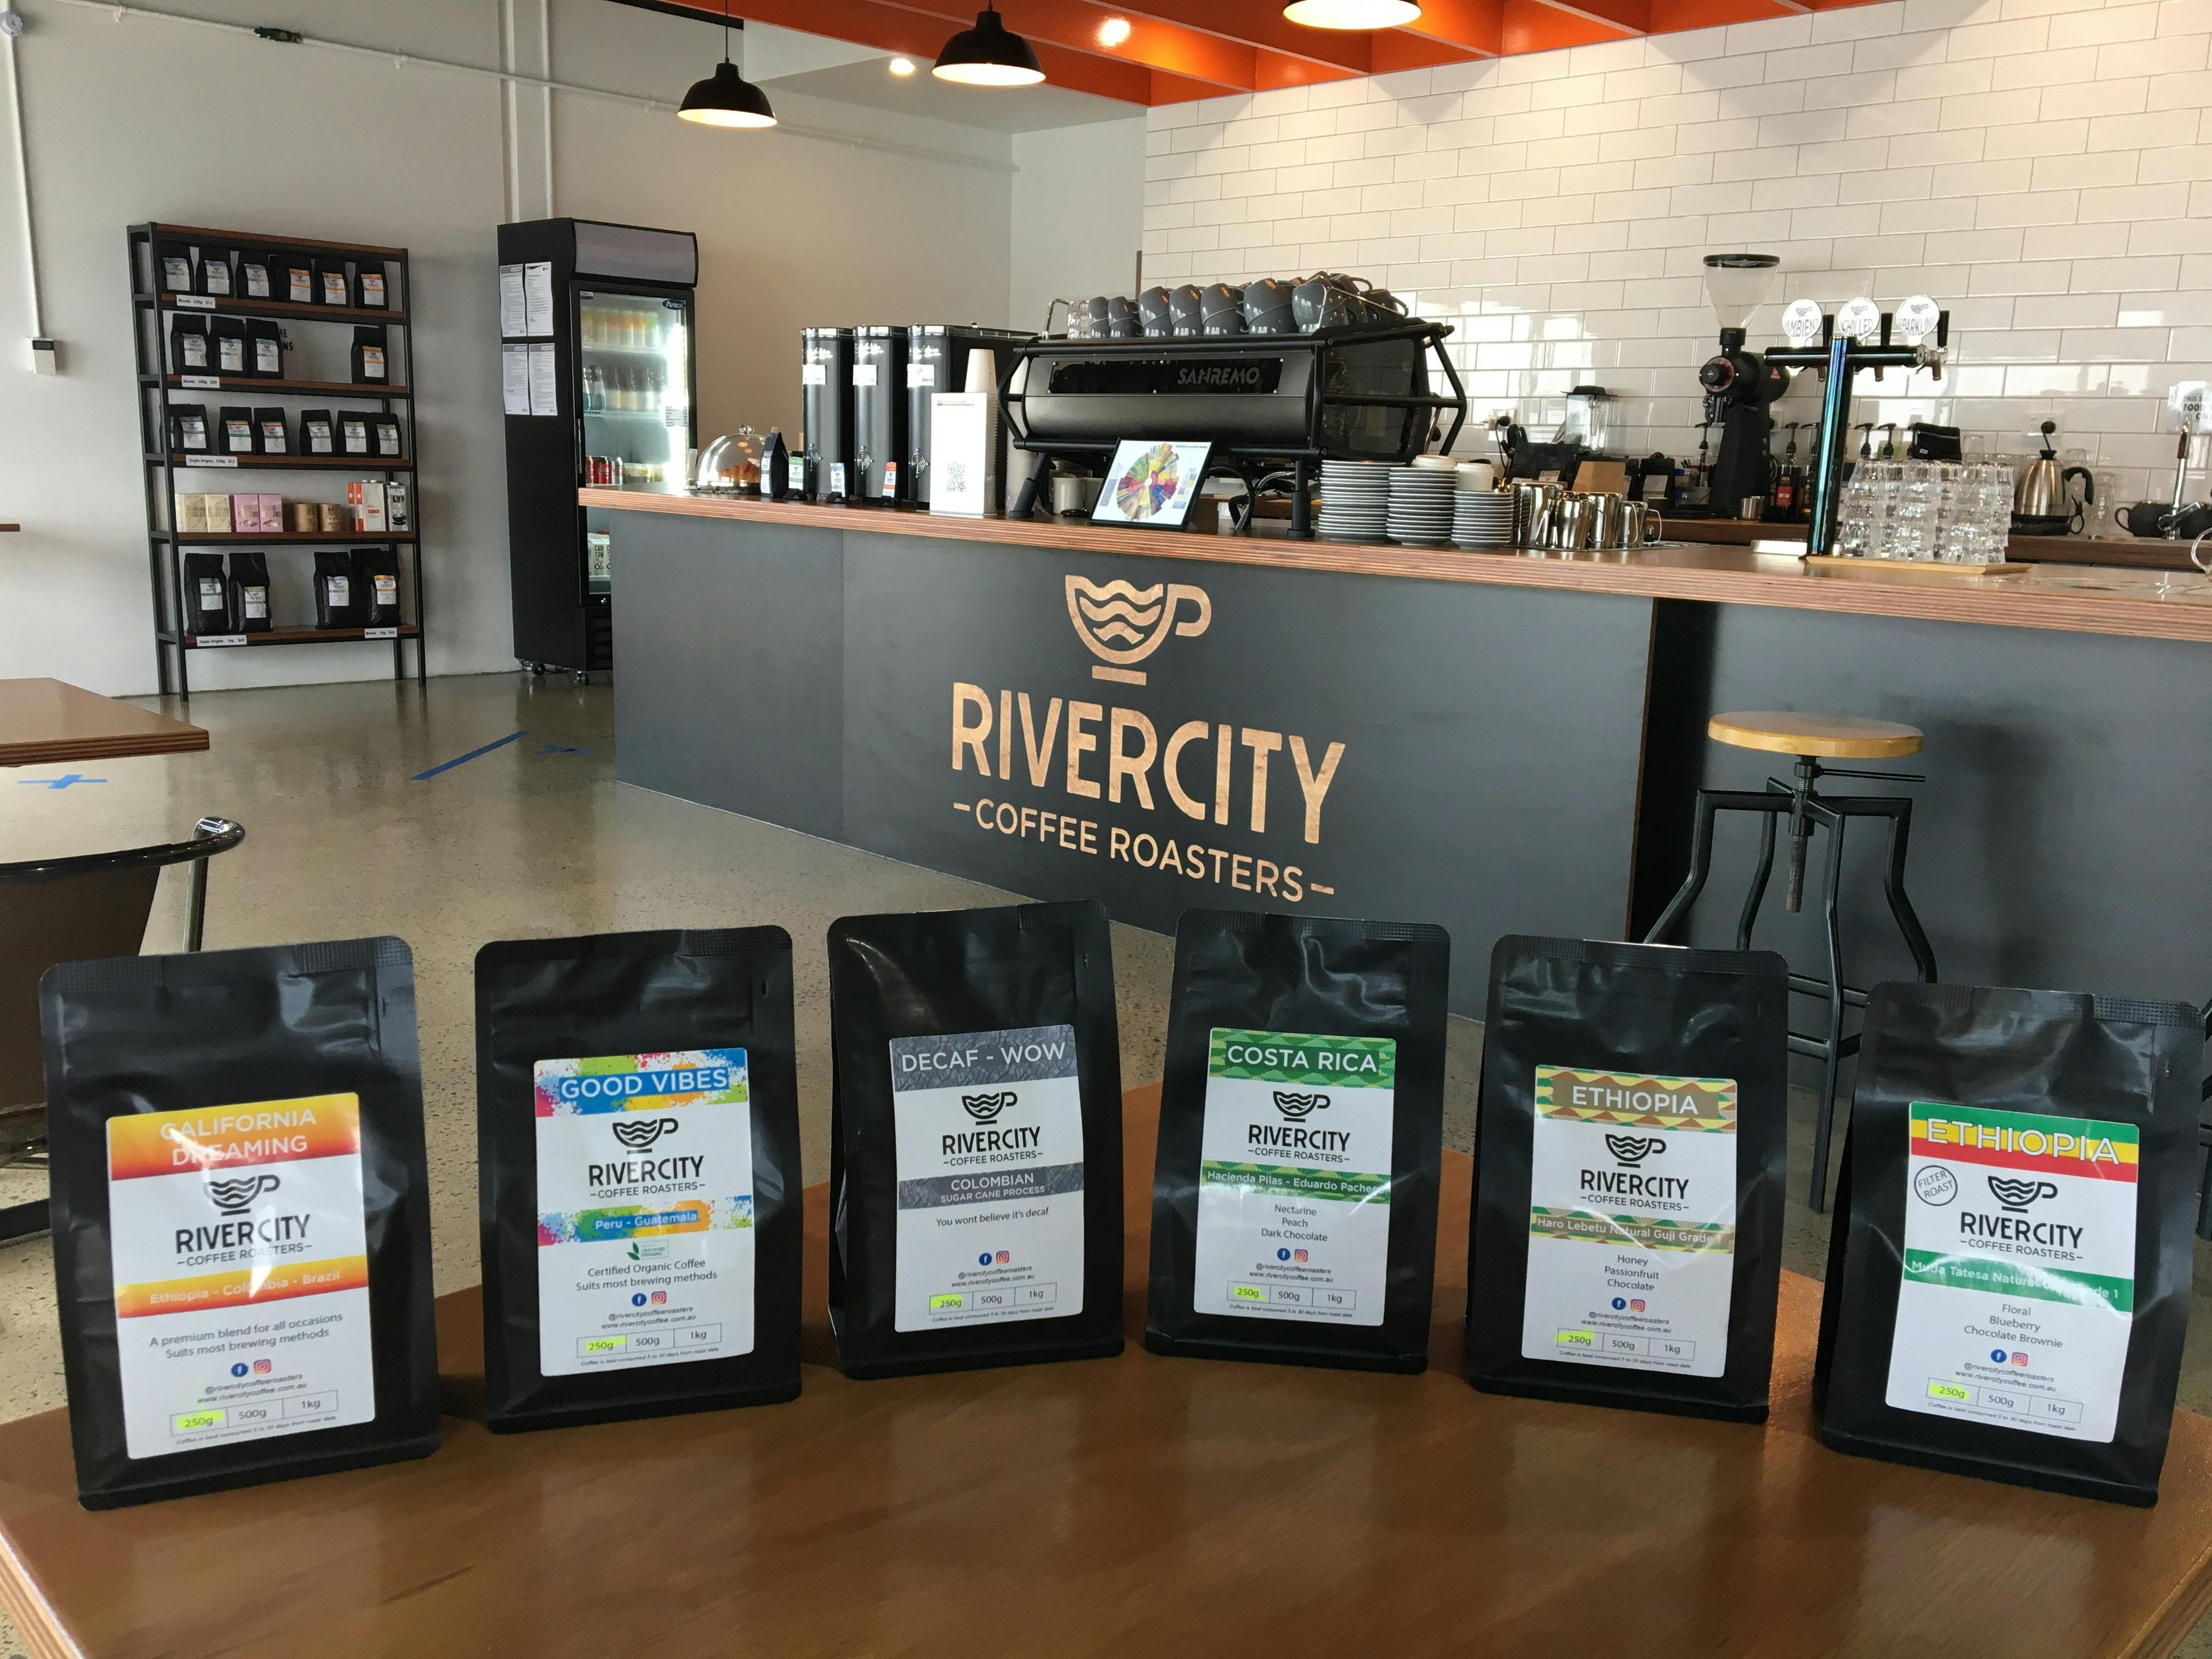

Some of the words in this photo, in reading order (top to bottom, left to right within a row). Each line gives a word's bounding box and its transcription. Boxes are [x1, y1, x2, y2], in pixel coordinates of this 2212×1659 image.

[1785, 318, 1819, 337] AMBIENT
[1842, 318, 1874, 336] CHILLED
[1899, 317, 1937, 335] SPARKLING
[1177, 367, 1260, 385] SANREMO
[952, 682, 1346, 845] RIVERCITY
[902, 1049, 979, 1073] DECAF
[1001, 1042, 1065, 1064] WOW
[1227, 1045, 1310, 1068] COSTA
[1318, 1051, 1378, 1073] RICA
[561, 1075, 642, 1099] GOOD
[651, 1068, 727, 1092] VIBES
[1571, 1085, 1699, 1115] ETHIOPIA
[160, 1107, 317, 1141] CALIFORNIA
[943, 1126, 1041, 1155] RIVERCITY
[1248, 1124, 1350, 1152] RIVERCITY
[1925, 1117, 2122, 1166] ETHIOPIA
[589, 1155, 704, 1187] RIVERCITY
[951, 1172, 1034, 1191] COLOMBIAN
[1207, 1170, 1255, 1183] Hacienda
[1259, 1174, 1283, 1186] Pilas
[1293, 1177, 1338, 1190] Eduardo
[1918, 1170, 1947, 1189] FILTER
[940, 1192, 973, 1203] SUGAR
[976, 1189, 1003, 1199] CANE
[1006, 1185, 1045, 1197] PROCESS
[1580, 1169, 1689, 1200] RIVERCITY
[1923, 1180, 1954, 1199] ROAST
[595, 1218, 622, 1230] Peru
[634, 1211, 696, 1226] Guatemala
[936, 1217, 952, 1227] You
[955, 1215, 977, 1225] wont
[979, 1211, 1010, 1222] believe
[1025, 1206, 1049, 1217] decaf
[1274, 1204, 1317, 1216] Nectarine
[175, 1213, 312, 1254] RIVERCITY
[1282, 1217, 1308, 1228] Peach
[1537, 1217, 1564, 1229] Haro
[1567, 1220, 1606, 1234] Lebetu
[1610, 1224, 1650, 1238] Natural
[1654, 1229, 1675, 1242] Guji
[1679, 1231, 1713, 1244] Grade
[1960, 1211, 2083, 1249] RIVERCITY
[1261, 1228, 1282, 1238] Dark
[1283, 1229, 1328, 1242] Chocolate
[588, 1265, 629, 1278] Certified
[633, 1261, 672, 1276] Organic
[674, 1257, 706, 1270] Coffee
[1617, 1254, 1648, 1267] Honey
[576, 1280, 600, 1292] Suits
[602, 1279, 628, 1289] most
[630, 1274, 671, 1289] brewing
[673, 1269, 716, 1283] methods
[1604, 1265, 1659, 1280] Passionfruit
[1950, 1266, 1989, 1281] Tatesa
[2113, 1289, 2119, 1299] 1
[150, 1286, 208, 1307] Ethiopia
[302, 1269, 340, 1284] Brazil
[1607, 1278, 1655, 1291] Chocolate
[940, 1298, 961, 1310] 250g
[981, 1294, 1002, 1305] 500g
[1029, 1289, 1043, 1299] 1kg
[1237, 1288, 1259, 1298] 250g
[1278, 1291, 1300, 1301] 500g
[1327, 1294, 1342, 1304] 1kg
[2002, 1303, 2031, 1317] Floral
[149, 1338, 159, 1347] A
[162, 1330, 215, 1348] premium
[218, 1324, 251, 1339] blend
[253, 1322, 269, 1334] for
[270, 1320, 286, 1331] all
[288, 1312, 342, 1329] occasions
[1989, 1315, 2040, 1334] Blueberry
[166, 1346, 194, 1360] Suits
[197, 1343, 225, 1355] most
[229, 1335, 276, 1353] brewing
[279, 1327, 329, 1344] methods
[589, 1341, 613, 1352] 250g
[635, 1336, 659, 1347] 500g
[690, 1330, 707, 1340] 1kg
[1568, 1335, 1591, 1346] 250g
[1612, 1339, 1635, 1350] 500g
[1664, 1344, 1680, 1354] 1kg
[1964, 1324, 2017, 1342] Chocolate
[2019, 1333, 2063, 1349] Brownie
[1955, 1369, 2056, 1392] www.rivercitycoffee.com.au
[1963, 1362, 2054, 1384] @rivercitycoffeeroasters
[1939, 1386, 1965, 1399] 250g
[1988, 1394, 2014, 1408] 500g
[2046, 1403, 2065, 1415] 1kg
[184, 1415, 213, 1430] 250g
[238, 1407, 267, 1421] 500g
[301, 1398, 320, 1410] 1kg
